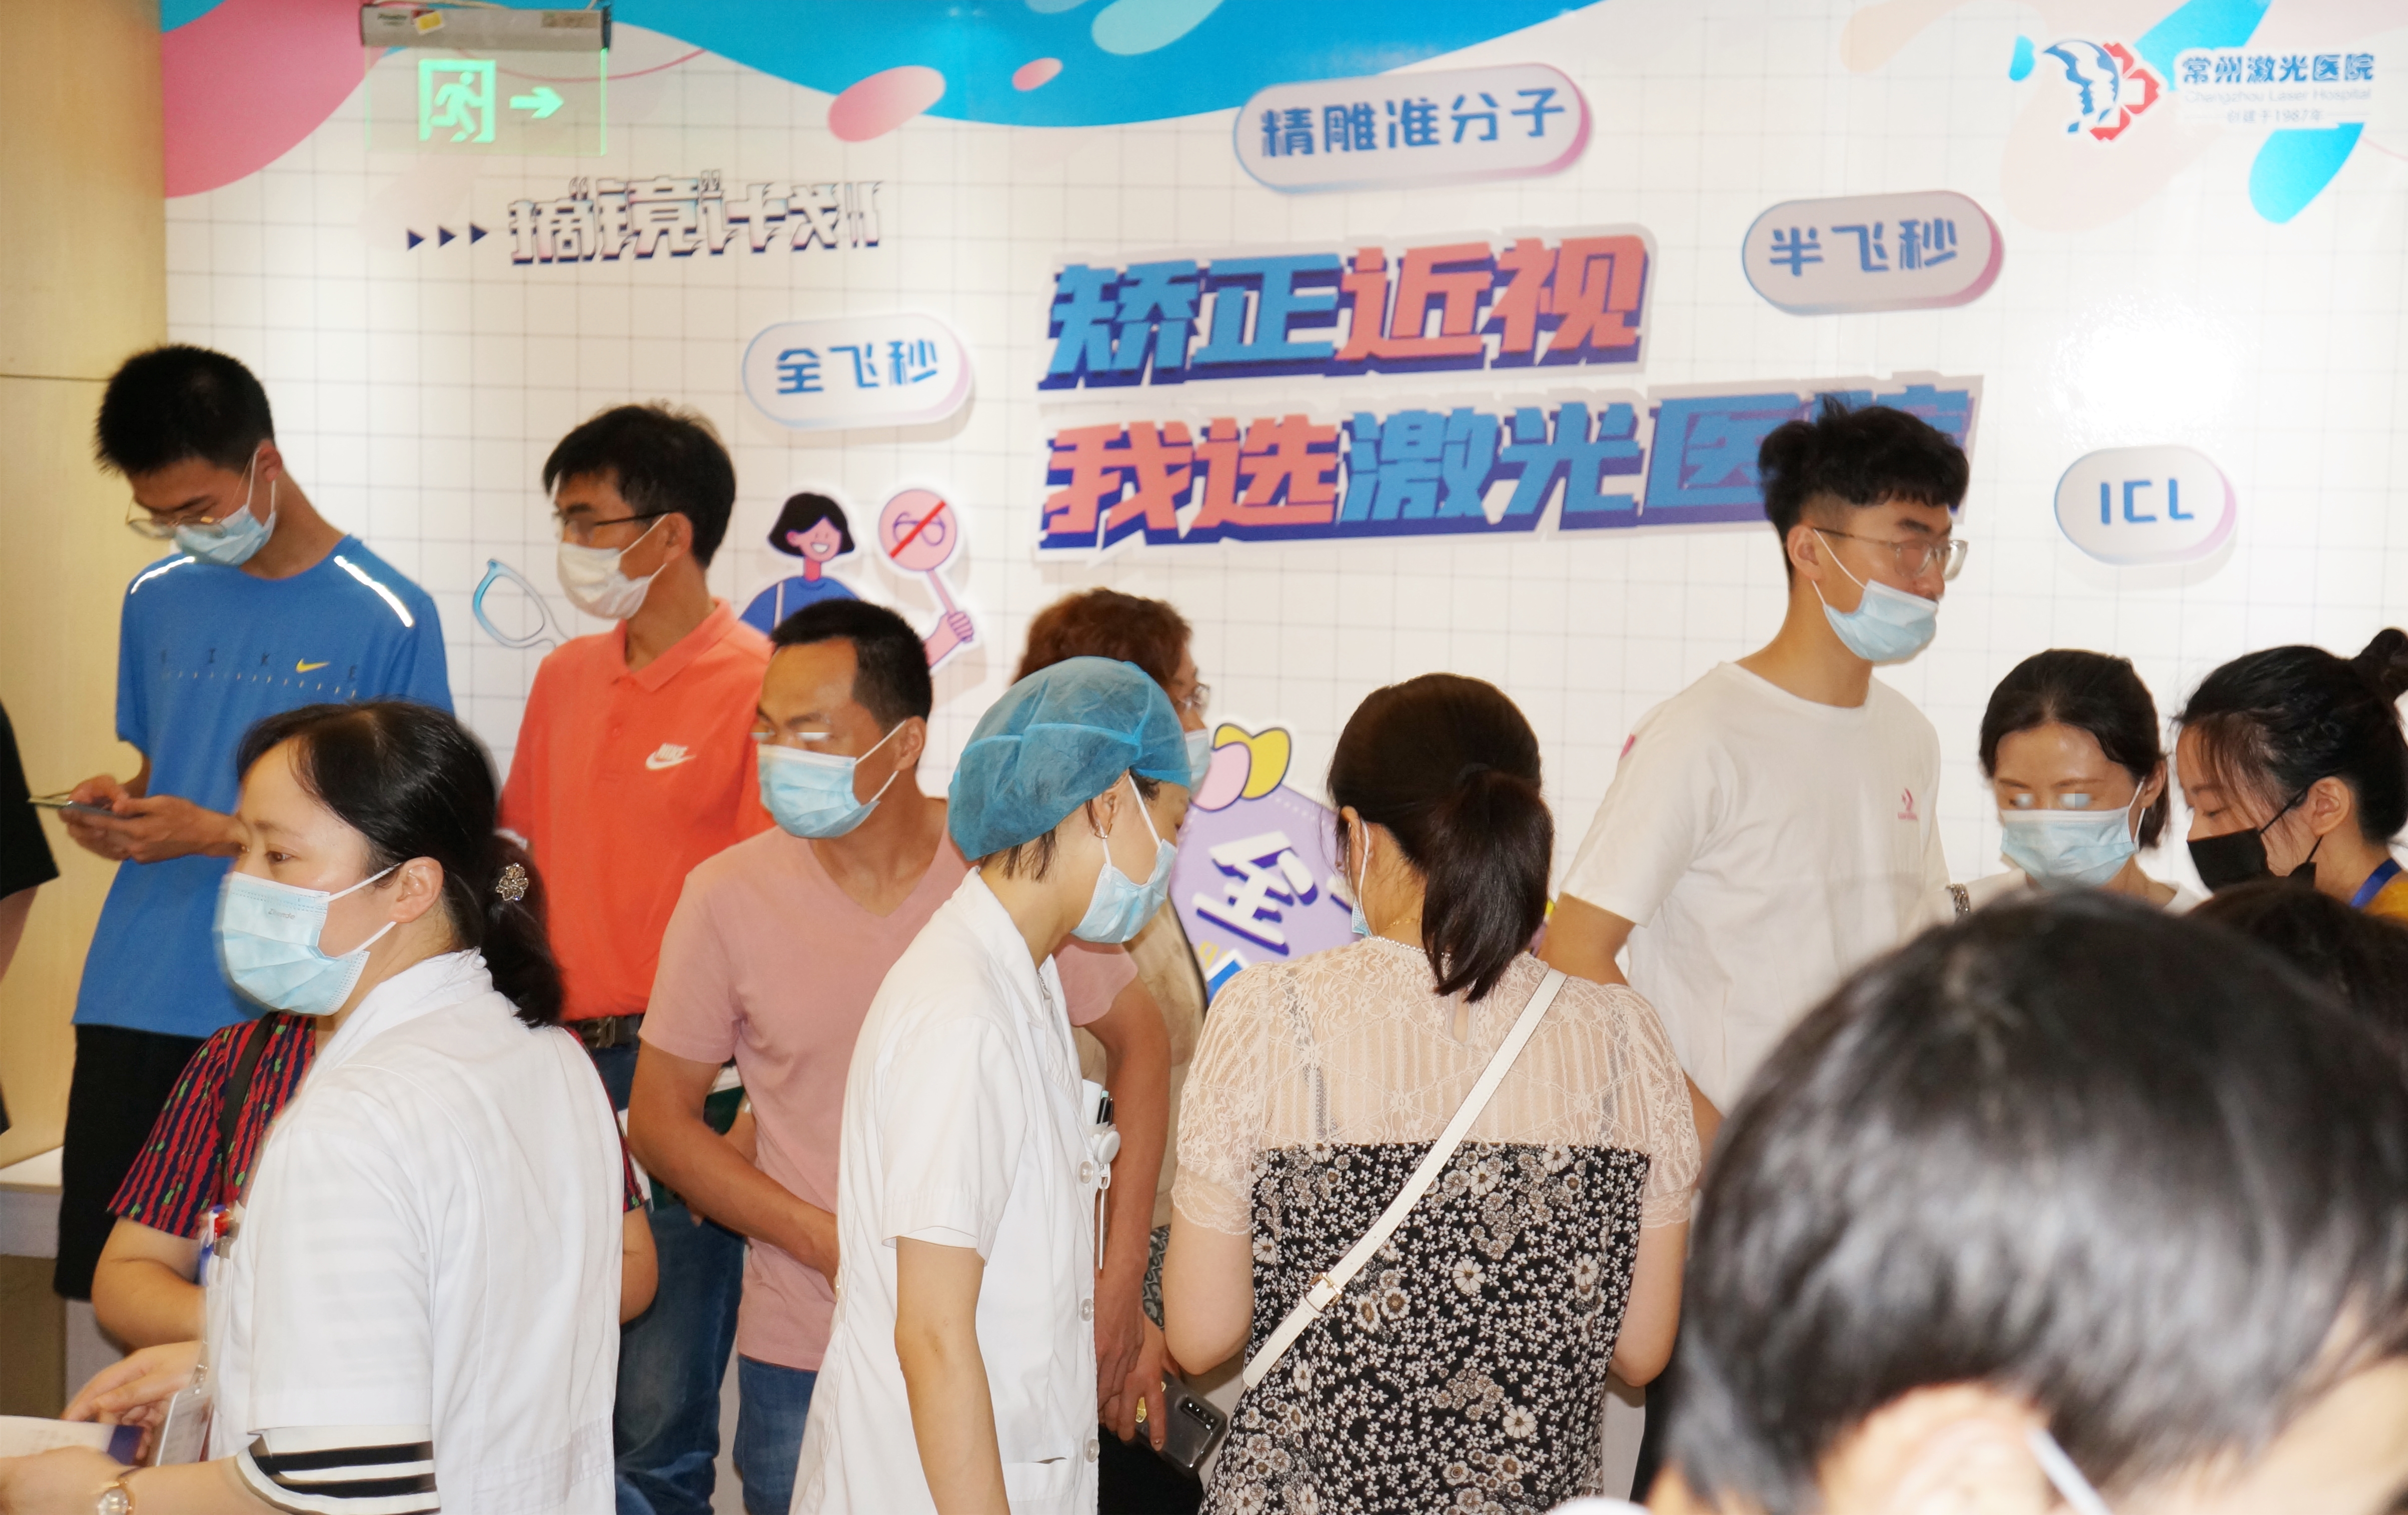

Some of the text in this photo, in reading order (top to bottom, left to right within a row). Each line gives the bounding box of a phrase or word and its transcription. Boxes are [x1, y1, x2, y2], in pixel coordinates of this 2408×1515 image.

[2182, 53, 2374, 84] 常州激光医院
[2268, 88, 2309, 102] Laser
[2312, 87, 2372, 103] Hospital
[1261, 87, 1566, 157] 精雕准分子
[1769, 217, 1957, 277] 半飞秒
[1037, 234, 1649, 390] 矫正近视
[776, 339, 938, 395] 全飞秒
[1037, 384, 1974, 550] 我选激光医
[2101, 478, 2194, 525] ICL
[1192, 831, 1354, 957] 全
